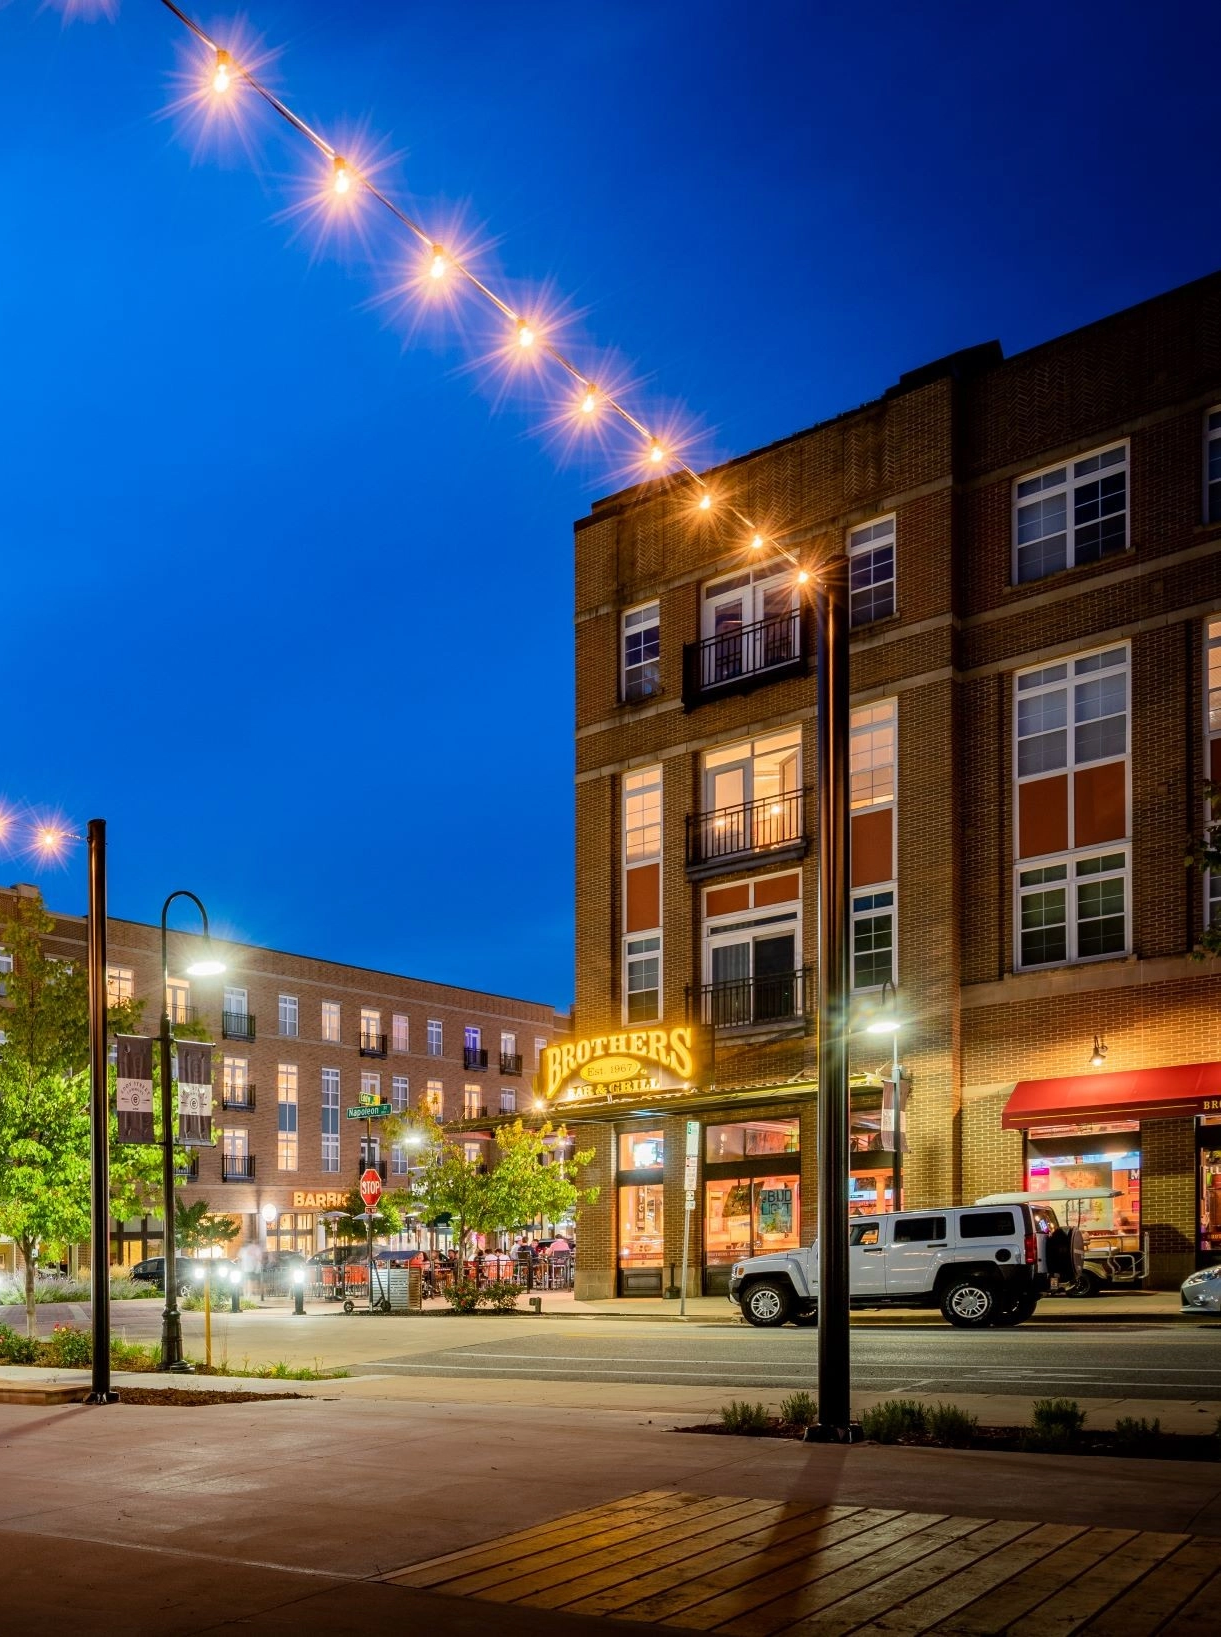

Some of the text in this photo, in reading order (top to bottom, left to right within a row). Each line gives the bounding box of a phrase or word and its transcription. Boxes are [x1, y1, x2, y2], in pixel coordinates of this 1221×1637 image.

[546, 1027, 693, 1100] BROTHERS
[610, 1063, 633, 1075] 1967
[567, 1078, 660, 1099] BAR & GRILL
[348, 1107, 379, 1117] Napoleon
[362, 1181, 379, 1195] STOP
